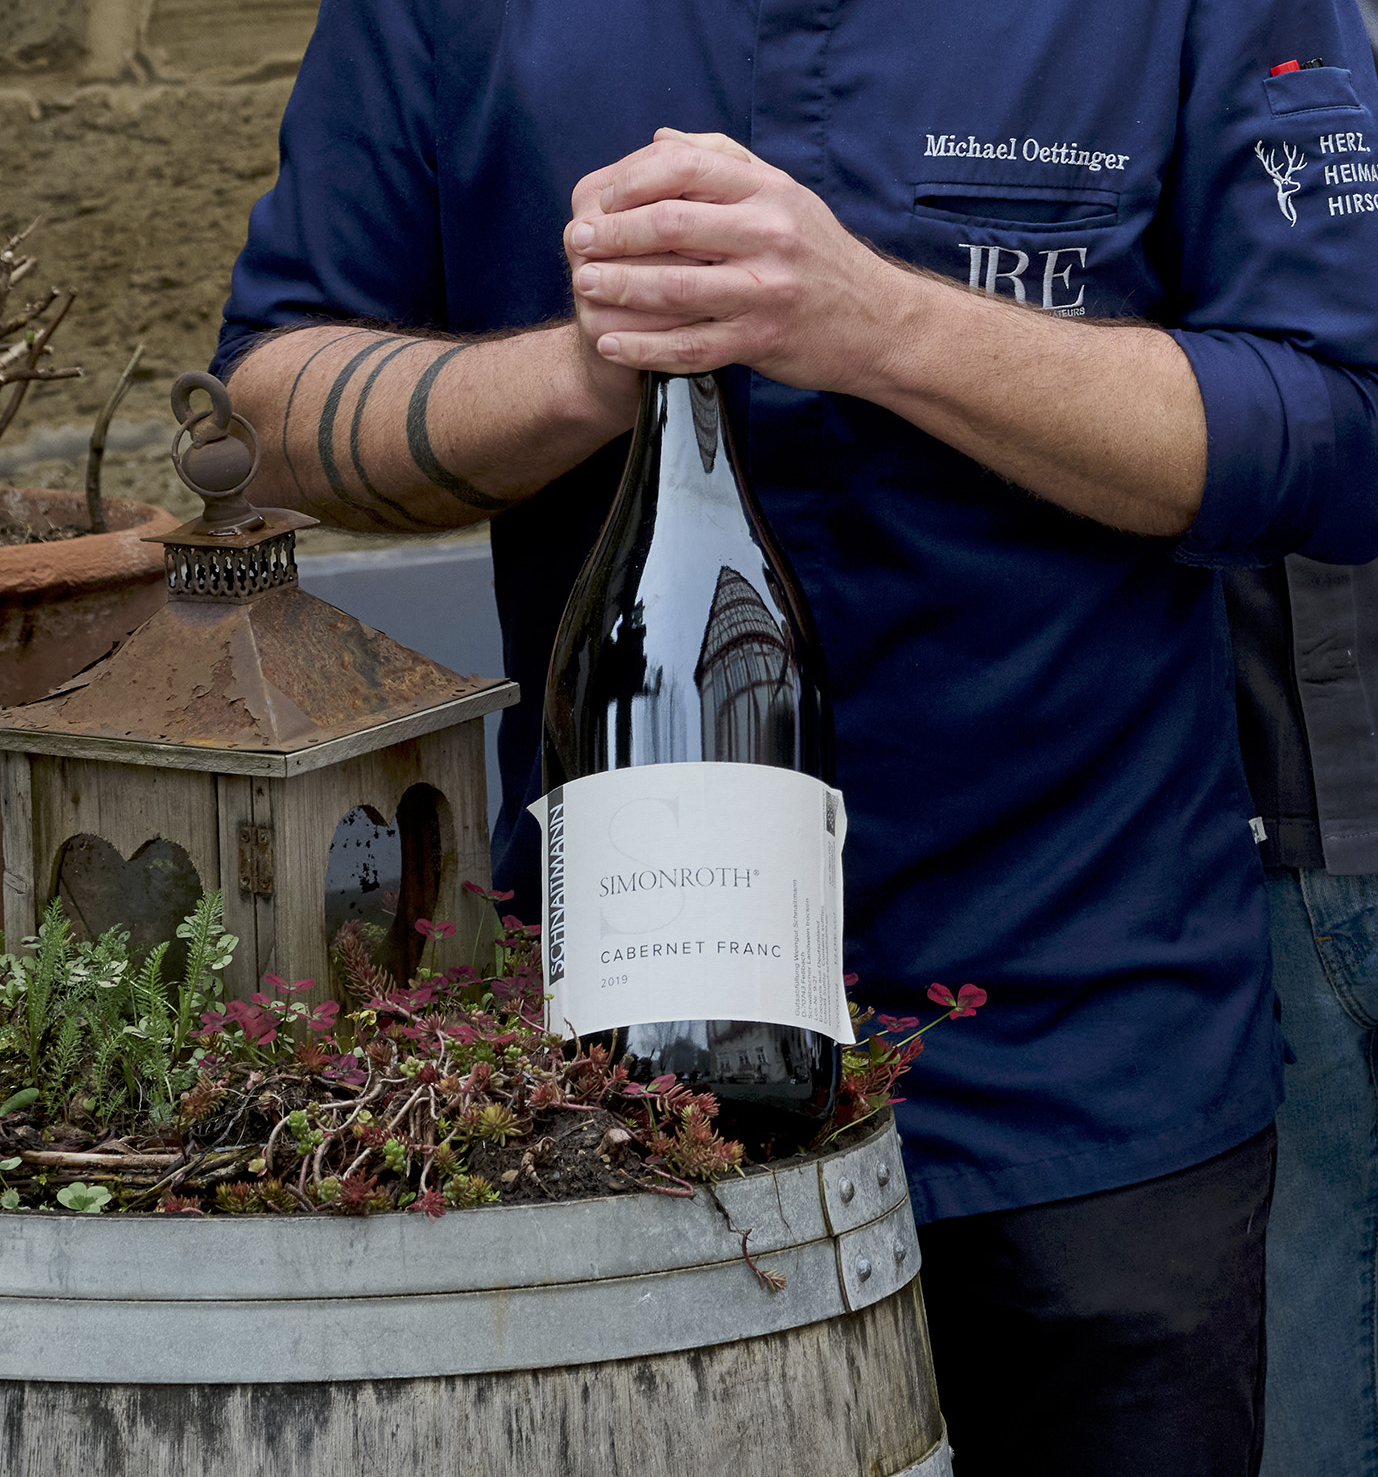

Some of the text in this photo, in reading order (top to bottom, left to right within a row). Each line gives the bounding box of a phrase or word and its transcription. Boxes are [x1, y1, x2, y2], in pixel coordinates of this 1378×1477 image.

[923, 134, 1130, 171] Michael Oettinger
[1320, 132, 1371, 154] HERZ.
[549, 802, 565, 977] SCHNAITMANN
[600, 941, 782, 964] CABERNET FRANC
[600, 974, 628, 988] 2019
